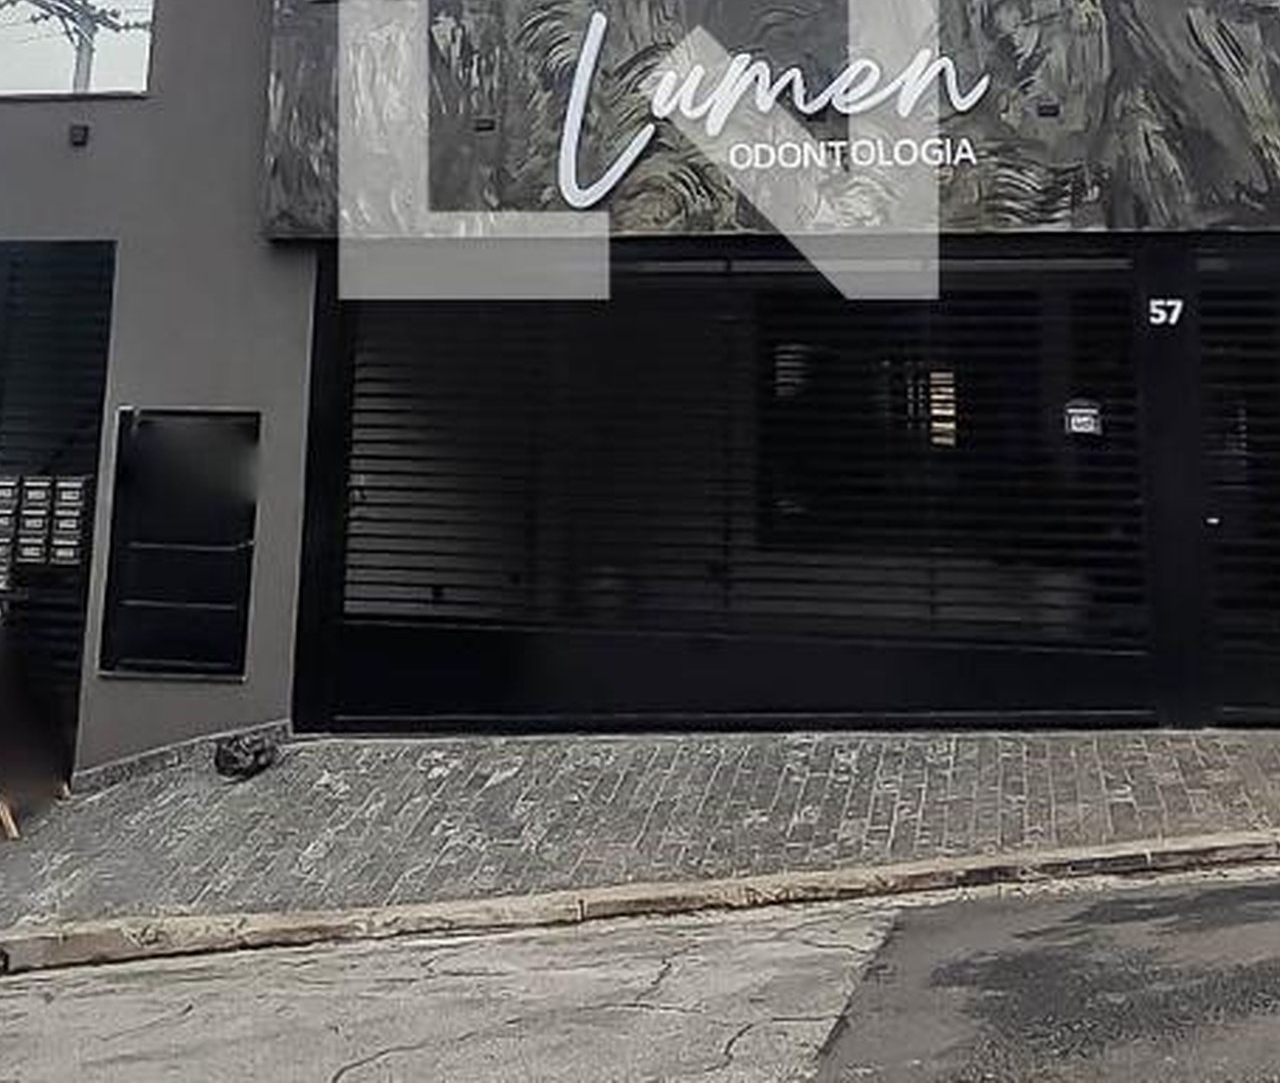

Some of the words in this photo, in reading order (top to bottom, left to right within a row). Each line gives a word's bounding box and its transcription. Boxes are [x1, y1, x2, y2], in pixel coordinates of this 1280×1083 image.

[556, 9, 990, 210] Lumen
[728, 135, 979, 172] ODONTOLOGIA
[1148, 298, 1184, 326] 57
